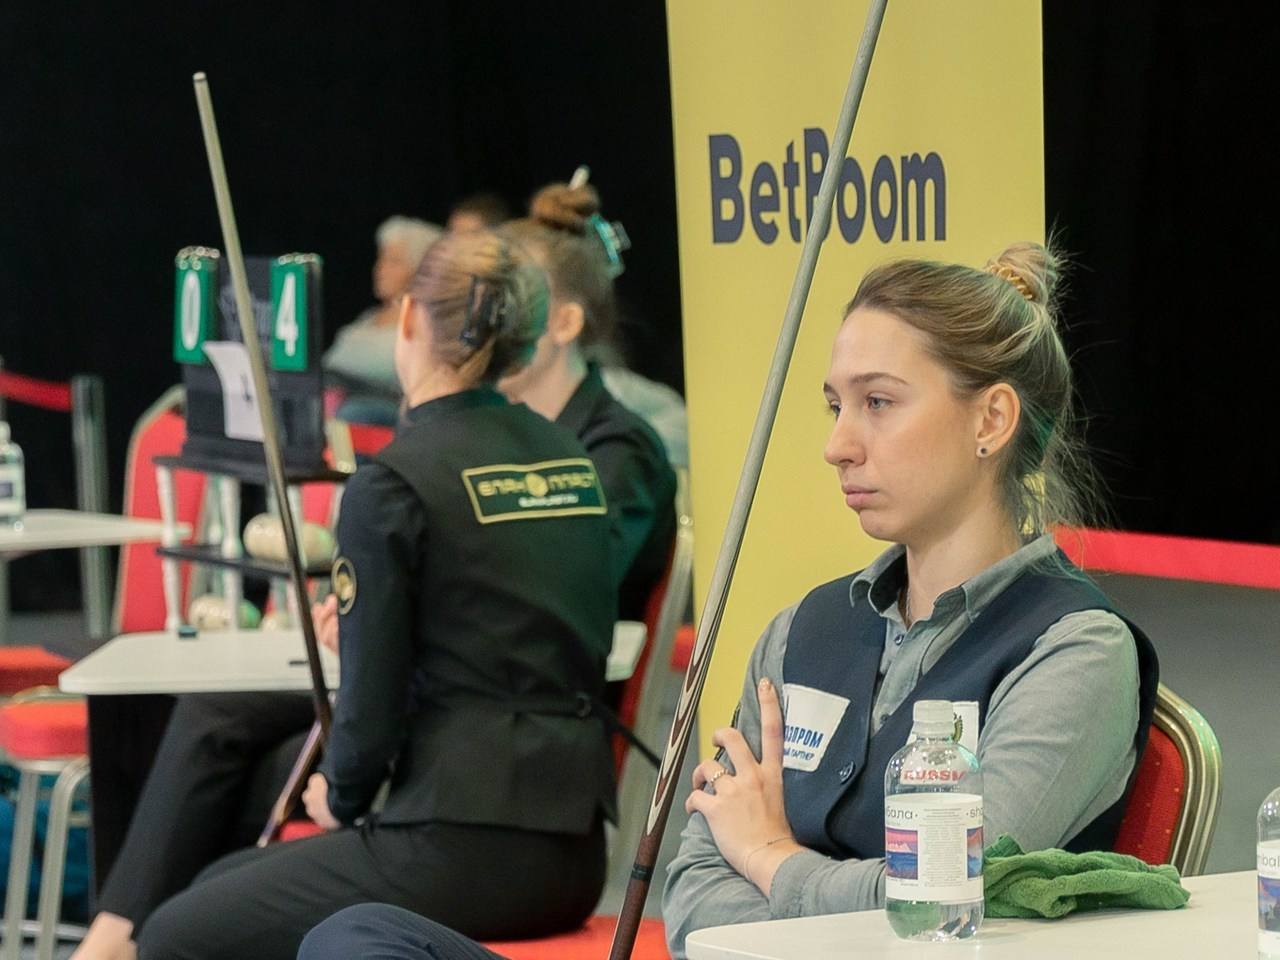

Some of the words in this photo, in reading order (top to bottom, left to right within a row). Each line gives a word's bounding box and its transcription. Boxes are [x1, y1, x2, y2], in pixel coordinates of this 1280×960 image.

[708, 127, 946, 245] BetBoom
[181, 270, 201, 350] 0
[275, 272, 299, 356] 4
